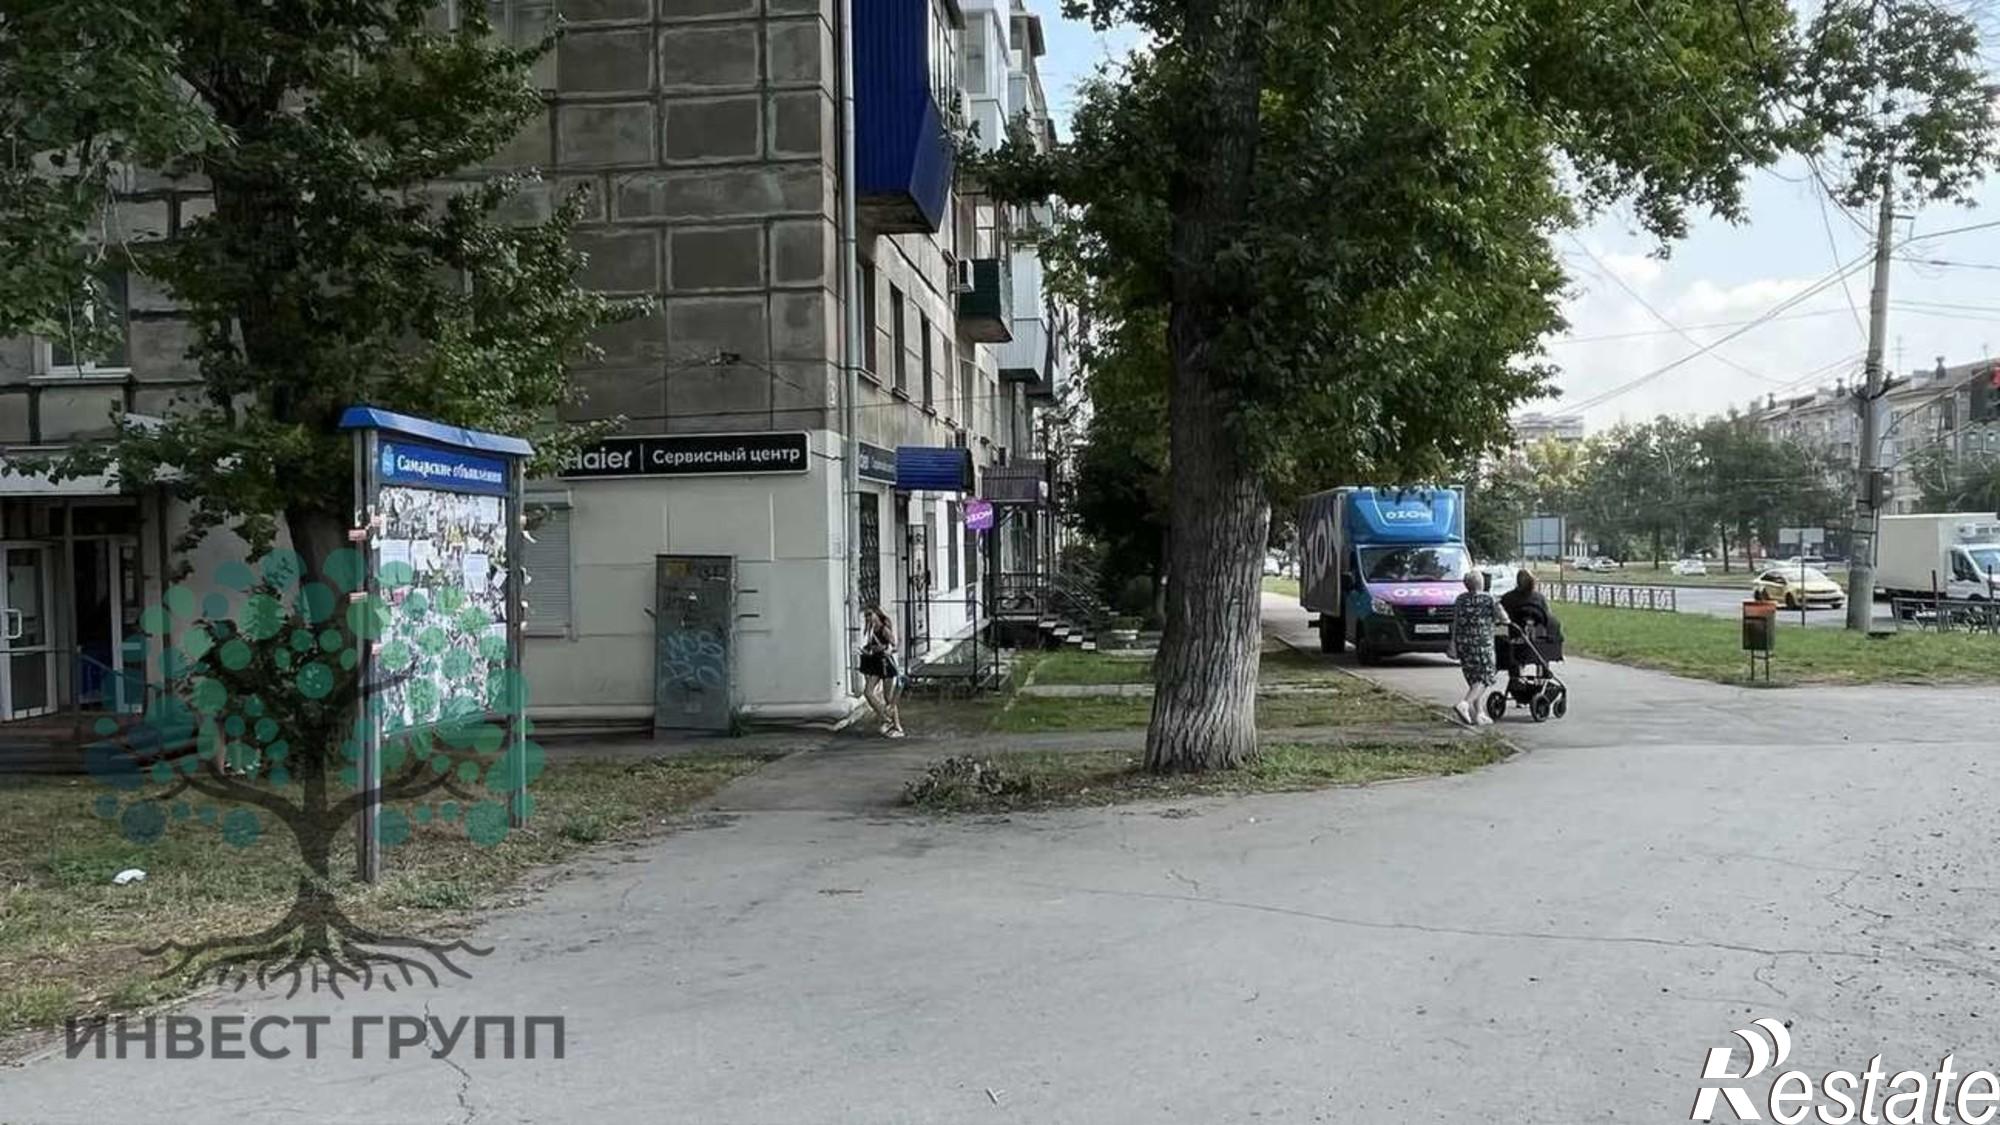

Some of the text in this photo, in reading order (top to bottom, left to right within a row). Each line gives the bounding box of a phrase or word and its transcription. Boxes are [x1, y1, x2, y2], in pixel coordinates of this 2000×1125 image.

[397, 454, 503, 483] Самарские объявления
[652, 447, 801, 466] Сервисный центр
